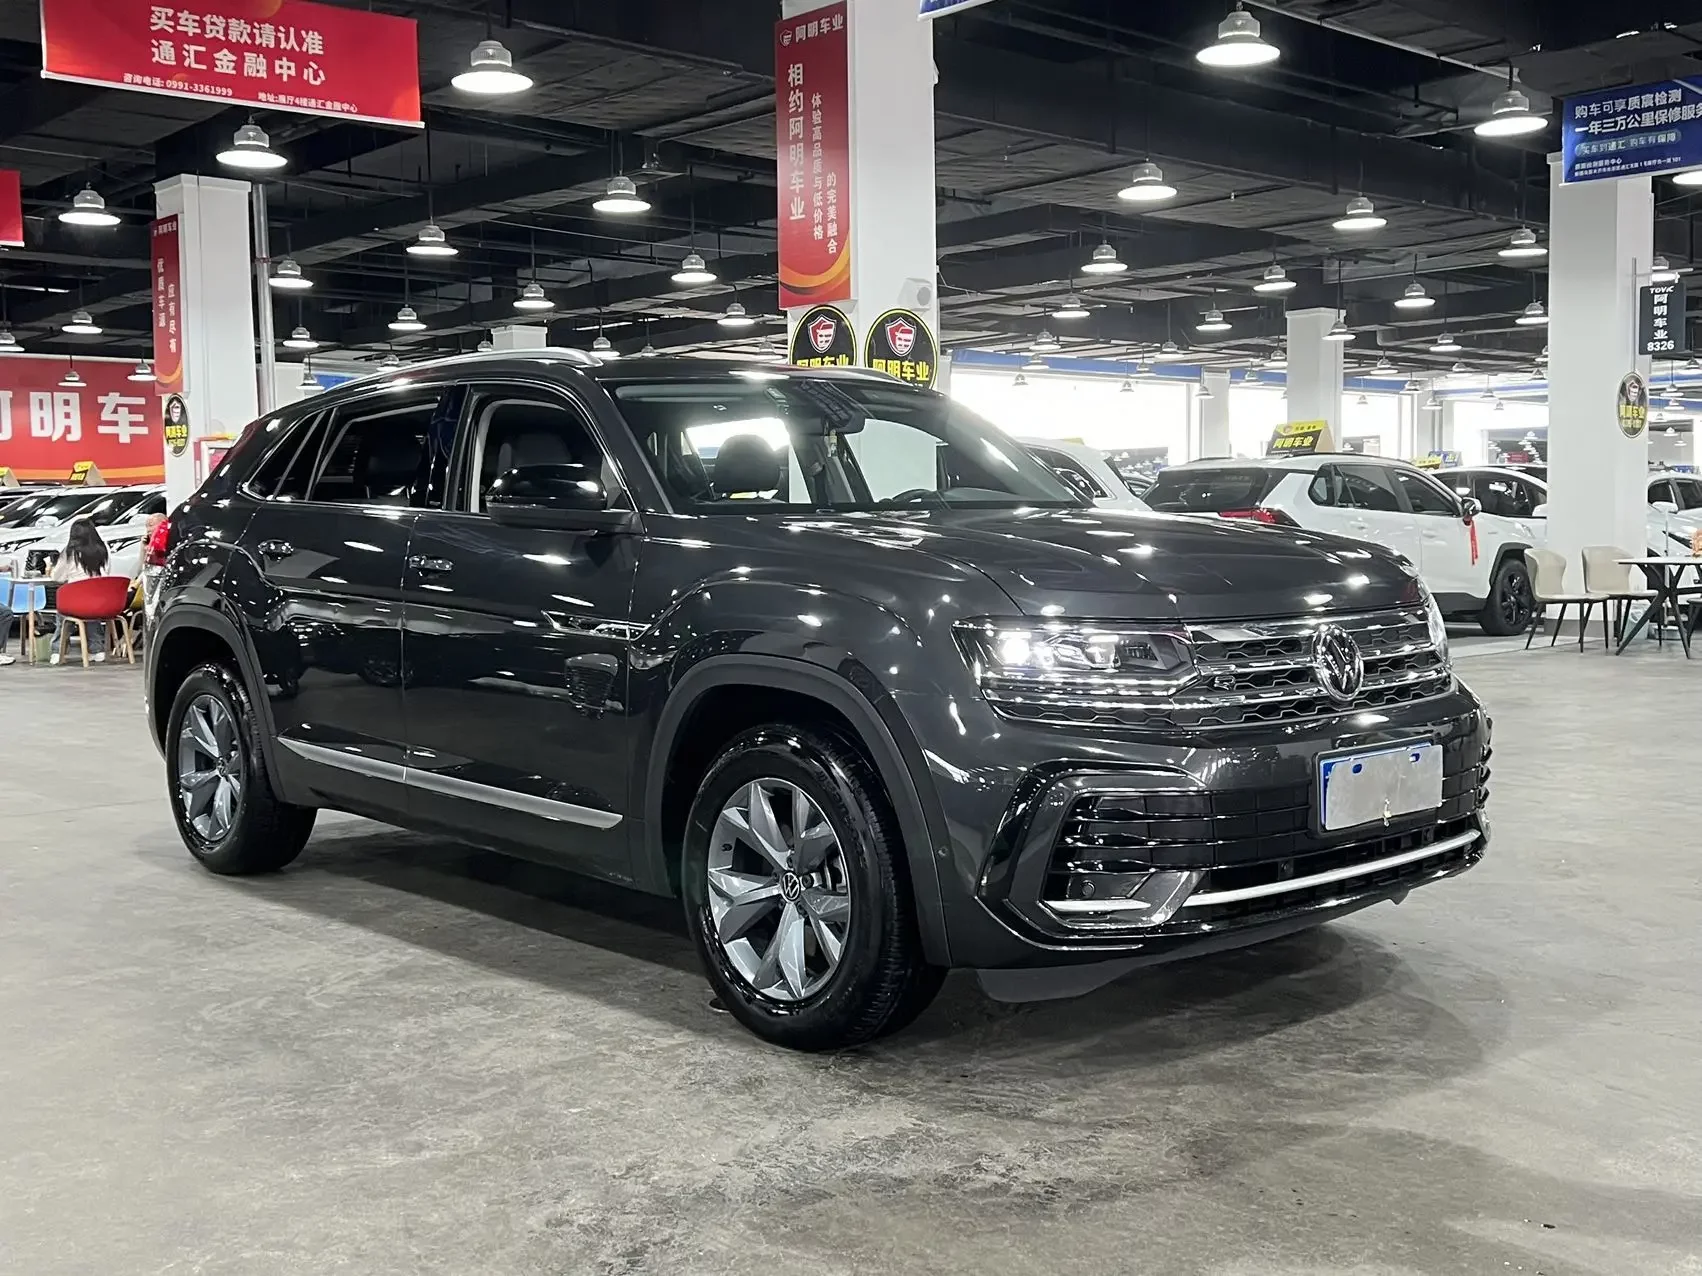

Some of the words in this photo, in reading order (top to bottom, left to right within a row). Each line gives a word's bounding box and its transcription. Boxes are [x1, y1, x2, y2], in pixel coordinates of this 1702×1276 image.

[150, 6, 324, 55] 买车贷款请认准
[795, 13, 844, 43] 阿明车业
[151, 39, 326, 86] 通汇金融中心
[166, 80, 233, 96] 0991-3361999
[788, 63, 806, 221] 相约阿明车业
[811, 92, 824, 241] 体验高品质与低价格
[826, 171, 838, 255] 的完美融合
[1653, 293, 1669, 340] 阿明车业
[1647, 340, 1675, 352] 8326
[0, 390, 149, 444] 明车
